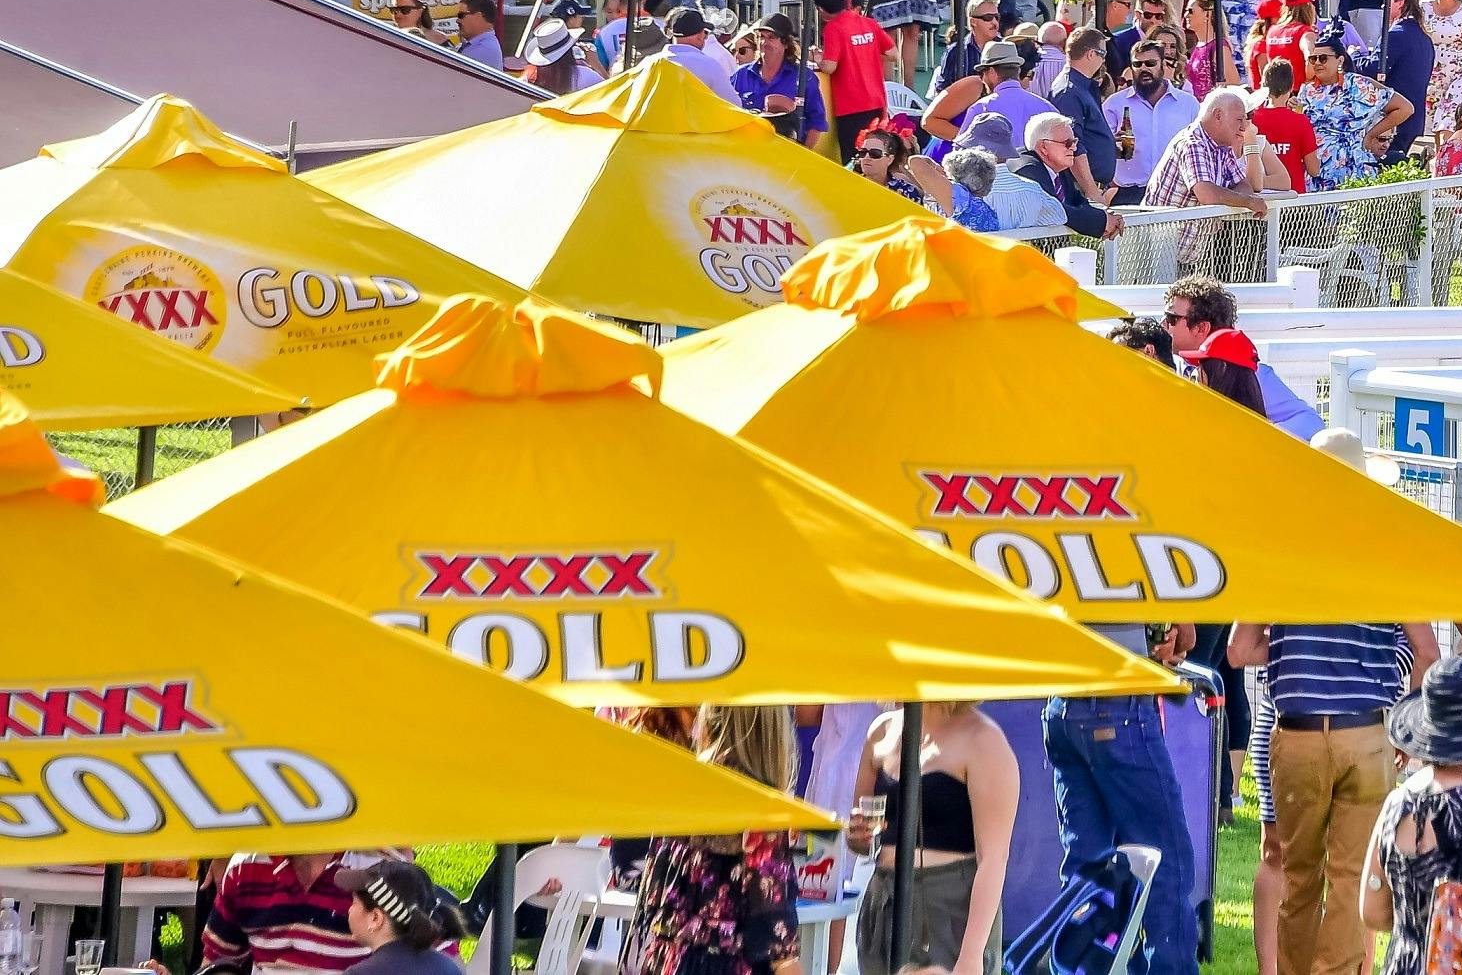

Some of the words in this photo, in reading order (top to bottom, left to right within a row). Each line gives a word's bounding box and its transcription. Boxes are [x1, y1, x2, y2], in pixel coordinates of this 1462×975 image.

[850, 31, 875, 46] STAFF
[702, 217, 810, 247] XXXX
[237, 266, 421, 329] GOLD
[1407, 408, 1432, 456] 5
[918, 472, 1138, 521] XXXX
[414, 552, 660, 598] XXXX
[912, 527, 1228, 602] OLD
[370, 610, 746, 685] OLD
